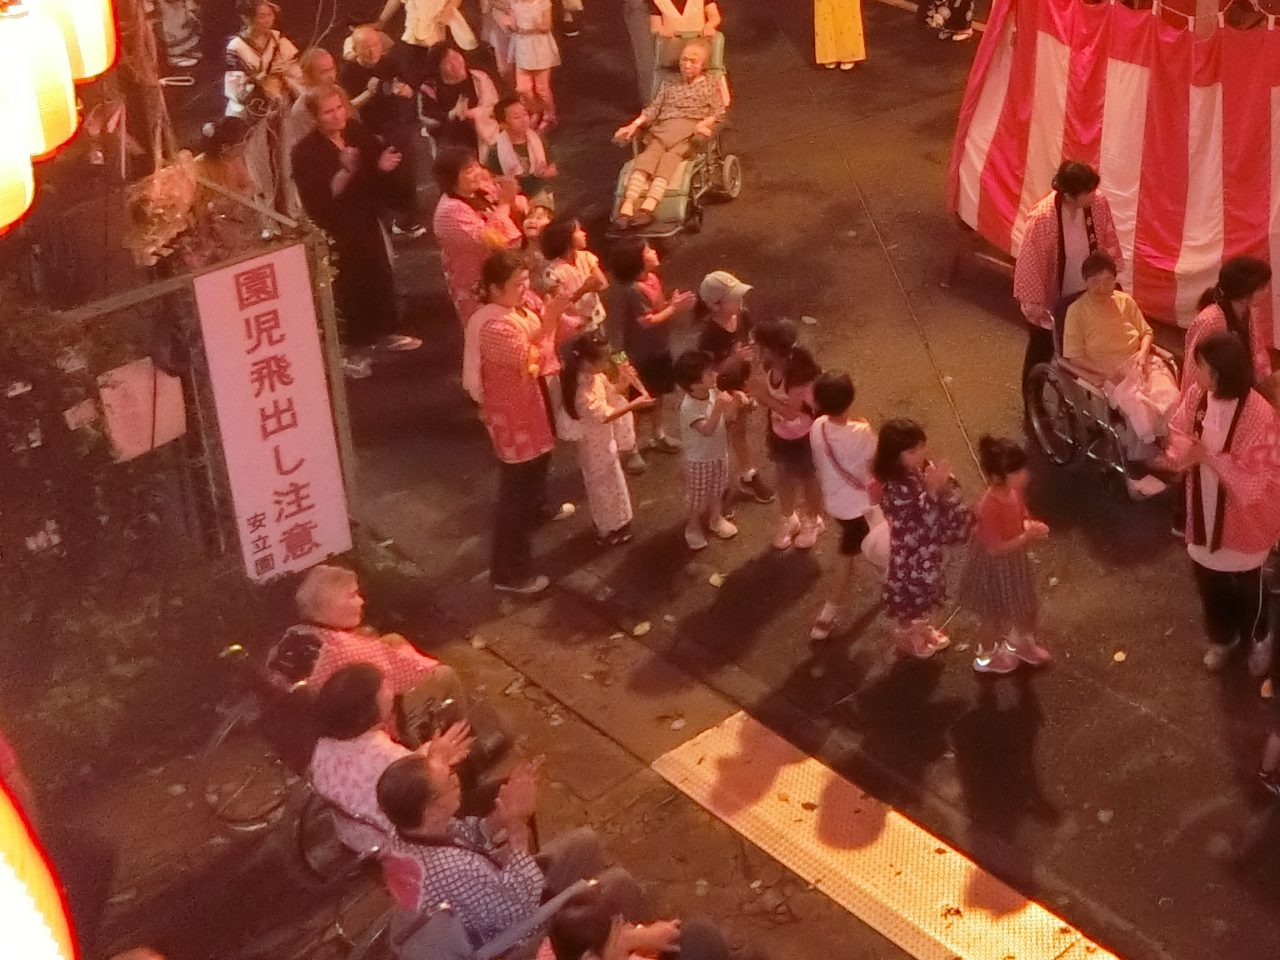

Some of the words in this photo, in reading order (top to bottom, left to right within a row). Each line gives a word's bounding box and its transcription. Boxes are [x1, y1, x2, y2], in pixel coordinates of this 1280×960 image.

[234, 262, 321, 563] 園児飛出し注意
[247, 512, 275, 576] 安立園
